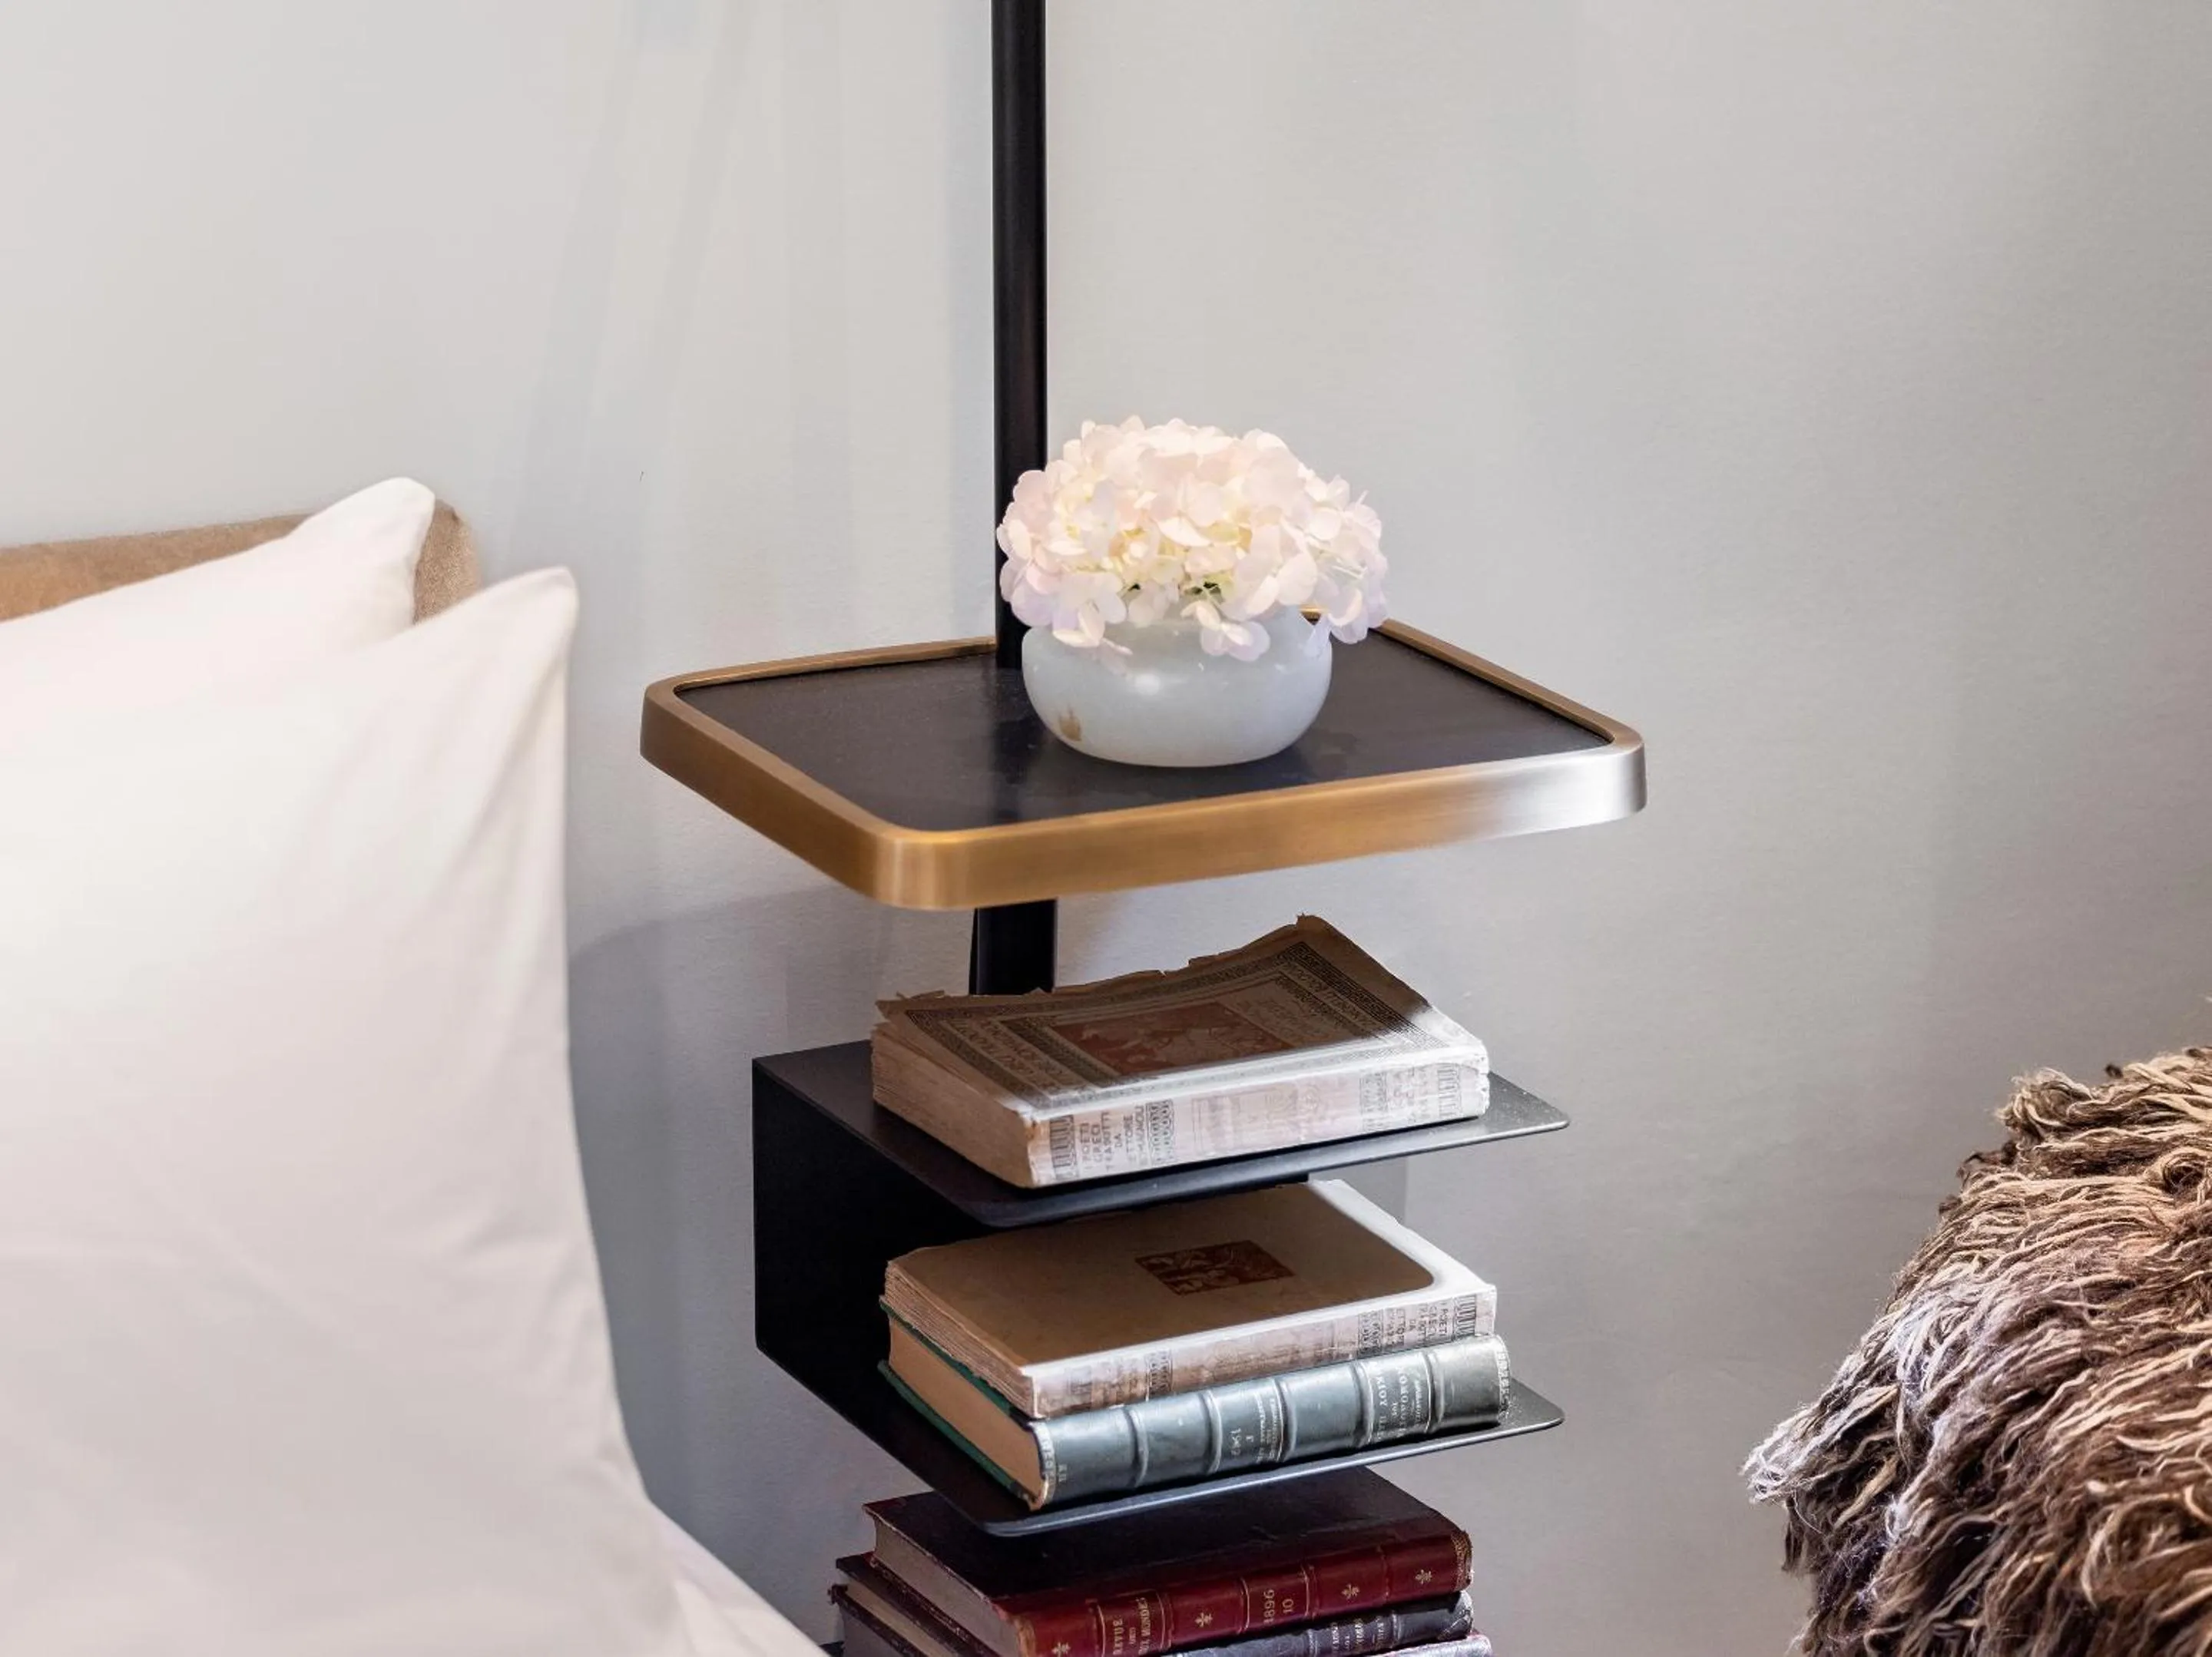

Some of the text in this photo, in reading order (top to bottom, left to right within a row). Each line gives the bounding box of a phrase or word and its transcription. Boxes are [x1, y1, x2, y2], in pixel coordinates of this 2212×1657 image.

[1080, 1123, 1091, 1163] POETI
[1091, 1123, 1102, 1163] GRECI
[1114, 1133, 1122, 1148] DA
[1123, 1115, 1136, 1162] ETTORE
[1263, 1589, 1275, 1623] 1896
[1281, 1599, 1293, 1614] 10
[1113, 1618, 1125, 1655] REVUE
